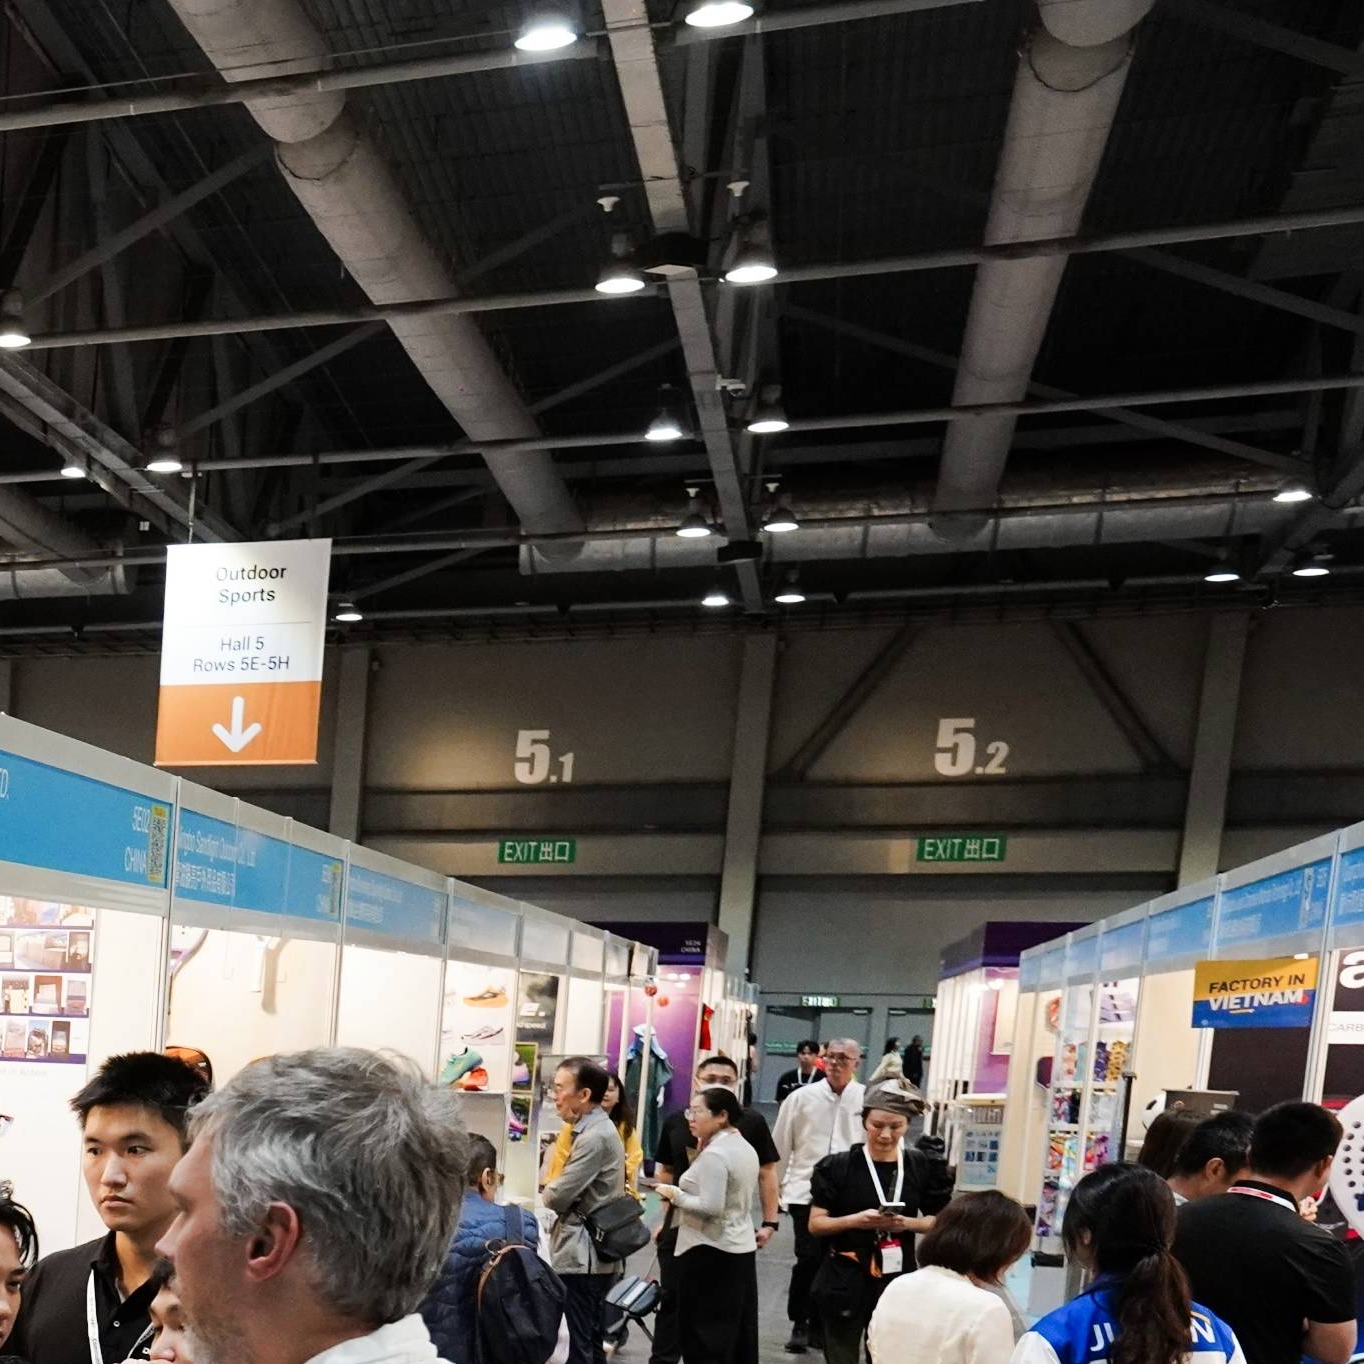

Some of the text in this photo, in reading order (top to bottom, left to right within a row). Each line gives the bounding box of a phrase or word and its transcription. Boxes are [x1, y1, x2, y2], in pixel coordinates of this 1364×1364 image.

[216, 564, 287, 582] Outdoor
[219, 587, 276, 606] Sports
[220, 636, 265, 652] Hall 5
[193, 656, 290, 673] Rows 5E-5H
[513, 729, 575, 785] 5.1
[934, 717, 1010, 777] 5.2
[503, 841, 570, 862] EXIT 出口
[923, 838, 1000, 860] EXIT 出口
[1209, 973, 1306, 994] FACTORY IN
[1208, 989, 1304, 1011] VIETNAM
